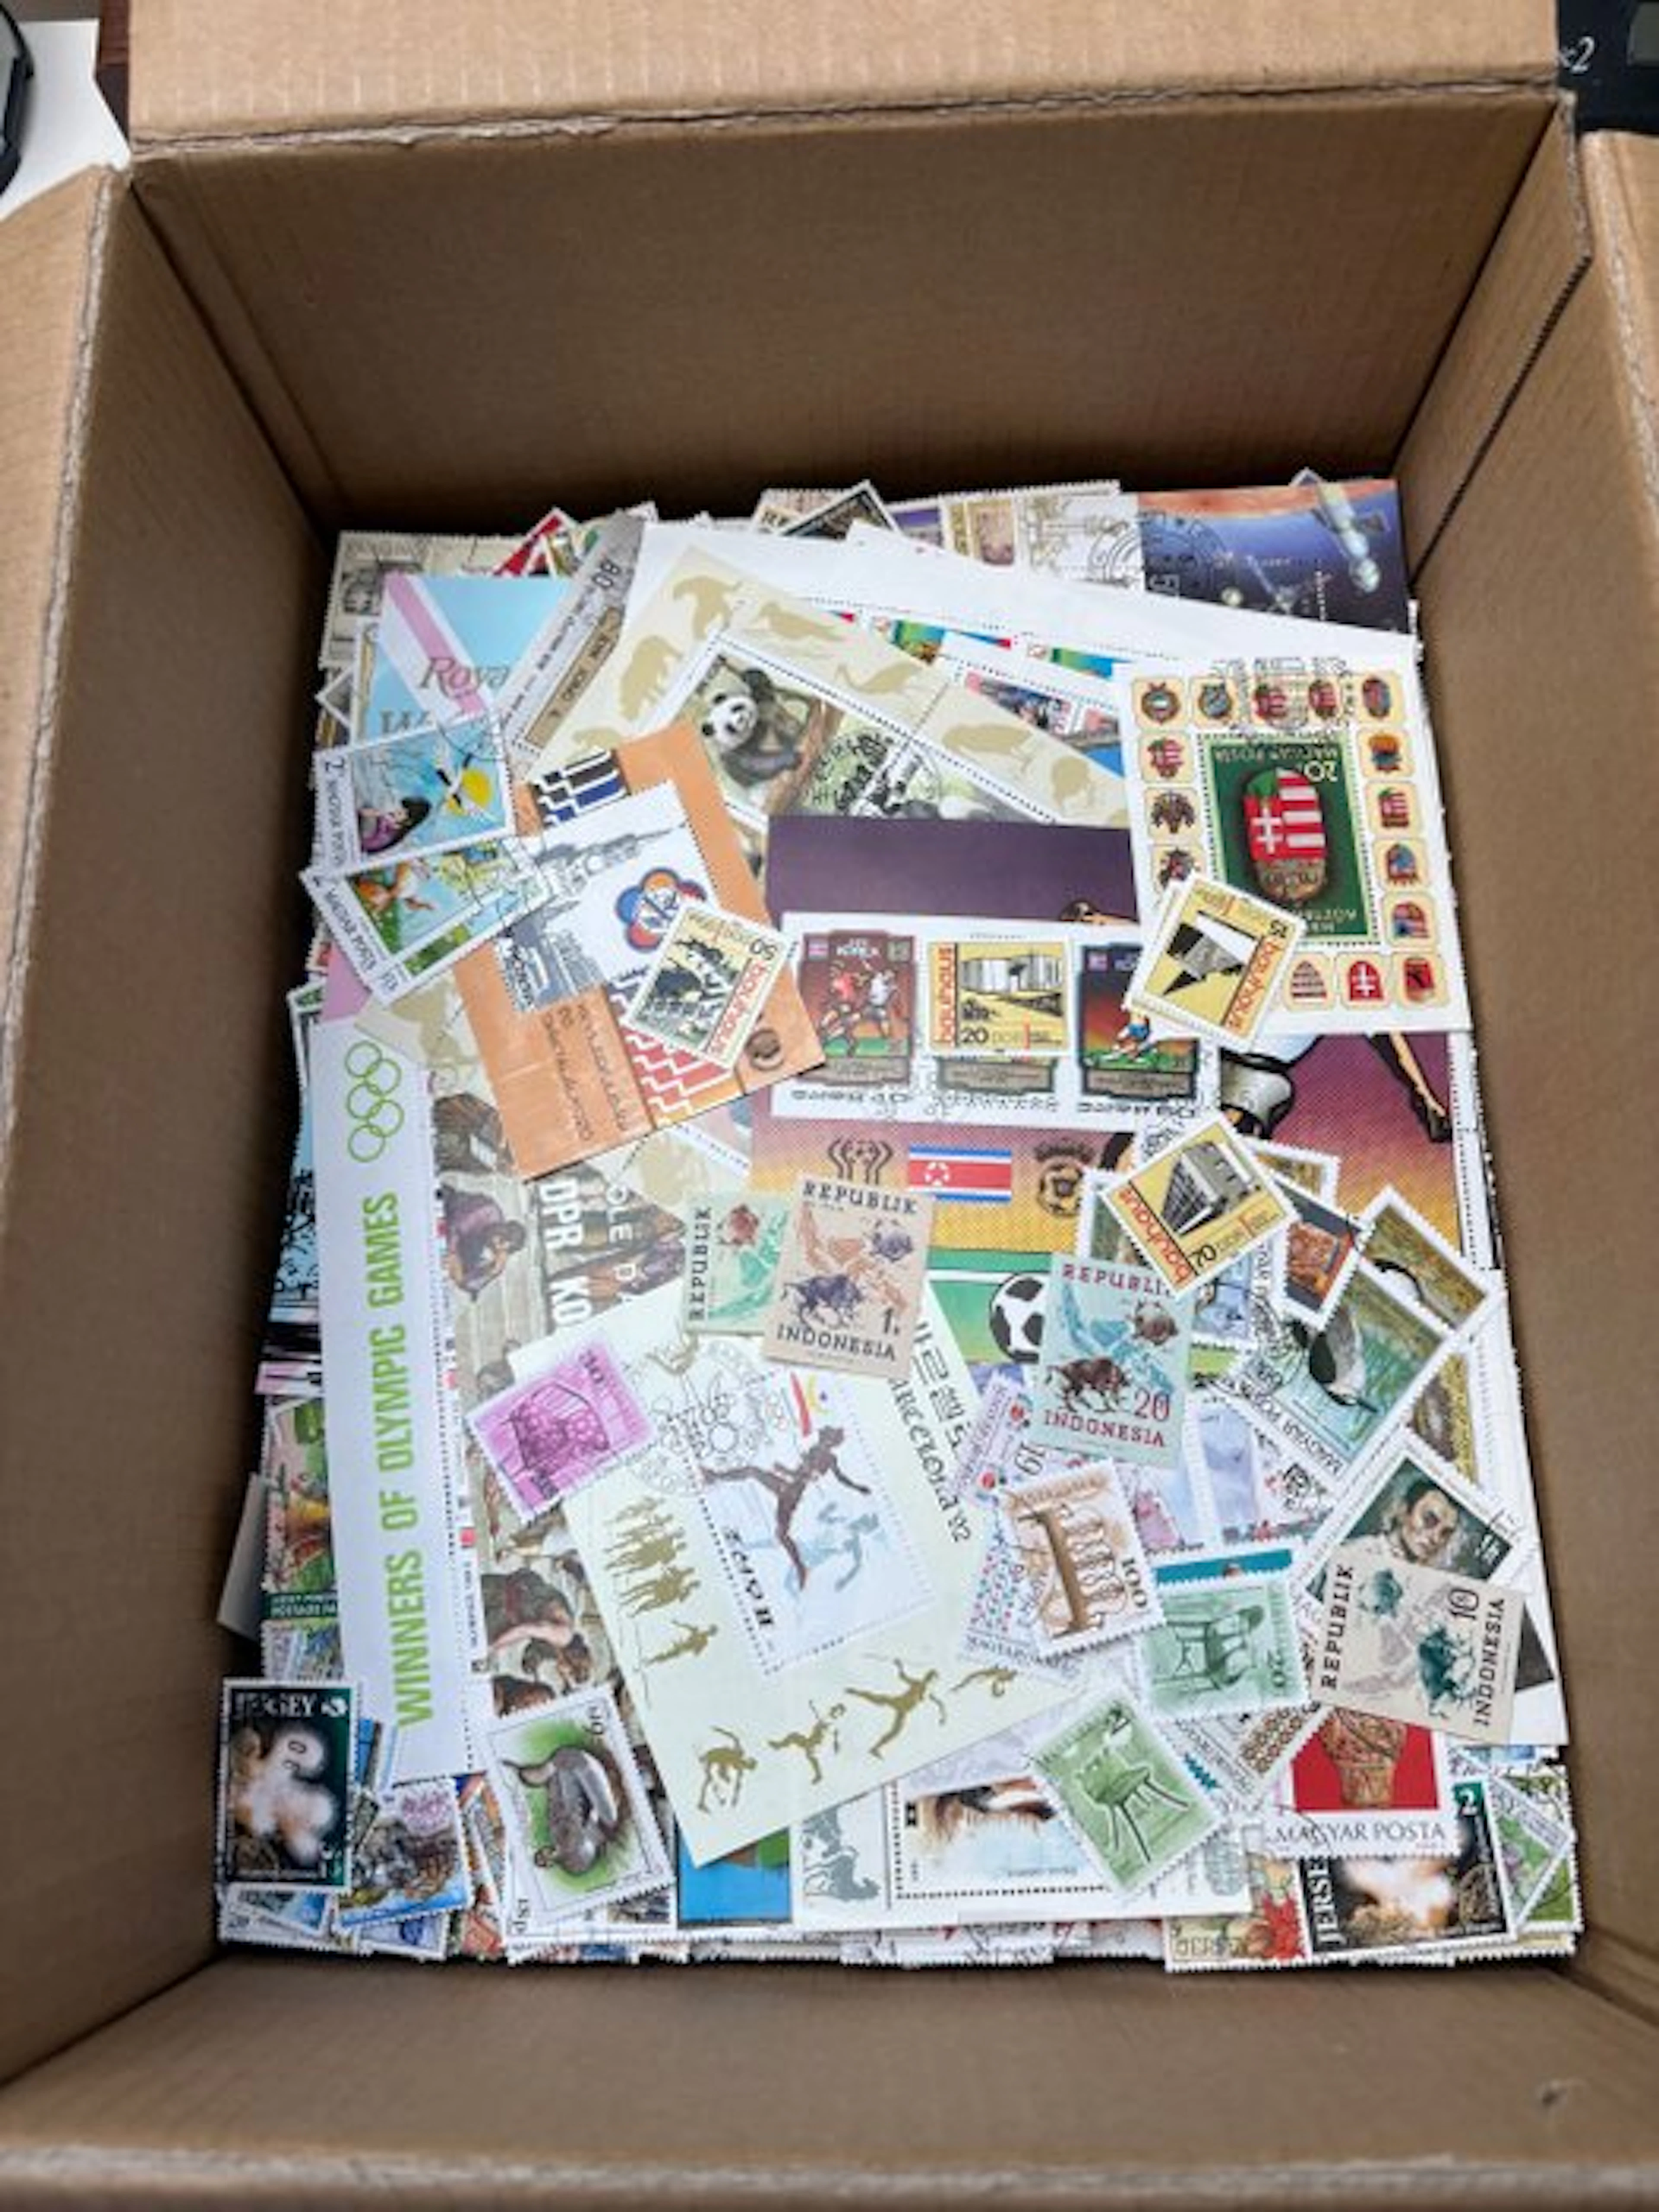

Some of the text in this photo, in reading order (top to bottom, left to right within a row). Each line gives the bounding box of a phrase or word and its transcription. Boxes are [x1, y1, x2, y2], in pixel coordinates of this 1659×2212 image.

[421, 657, 509, 696] Roya
[961, 1027, 989, 1045] 20
[540, 1179, 584, 1249] DPR
[803, 1180, 917, 1214] REPUBLIK
[1115, 1187, 1192, 1284] bauhaus
[688, 1207, 712, 1321] REPUBLIK
[1189, 1243, 1217, 1268] 70
[1062, 1263, 1170, 1295] REPUBLI
[778, 1324, 895, 1360] INDONESIA
[1134, 1387, 1170, 1422] 20
[1044, 1409, 1165, 1447] INDONESIA
[362, 1192, 432, 1728] WINNERS OF OLYMPIC GAMES
[1122, 1557, 1147, 1608] 100
[1321, 1564, 1354, 1690] REPUBLIK
[1472, 1598, 1504, 1727] INDONESIA
[1274, 1820, 1446, 1845] MAGYAR POSTA
[1306, 1857, 1348, 1945] JERSE
